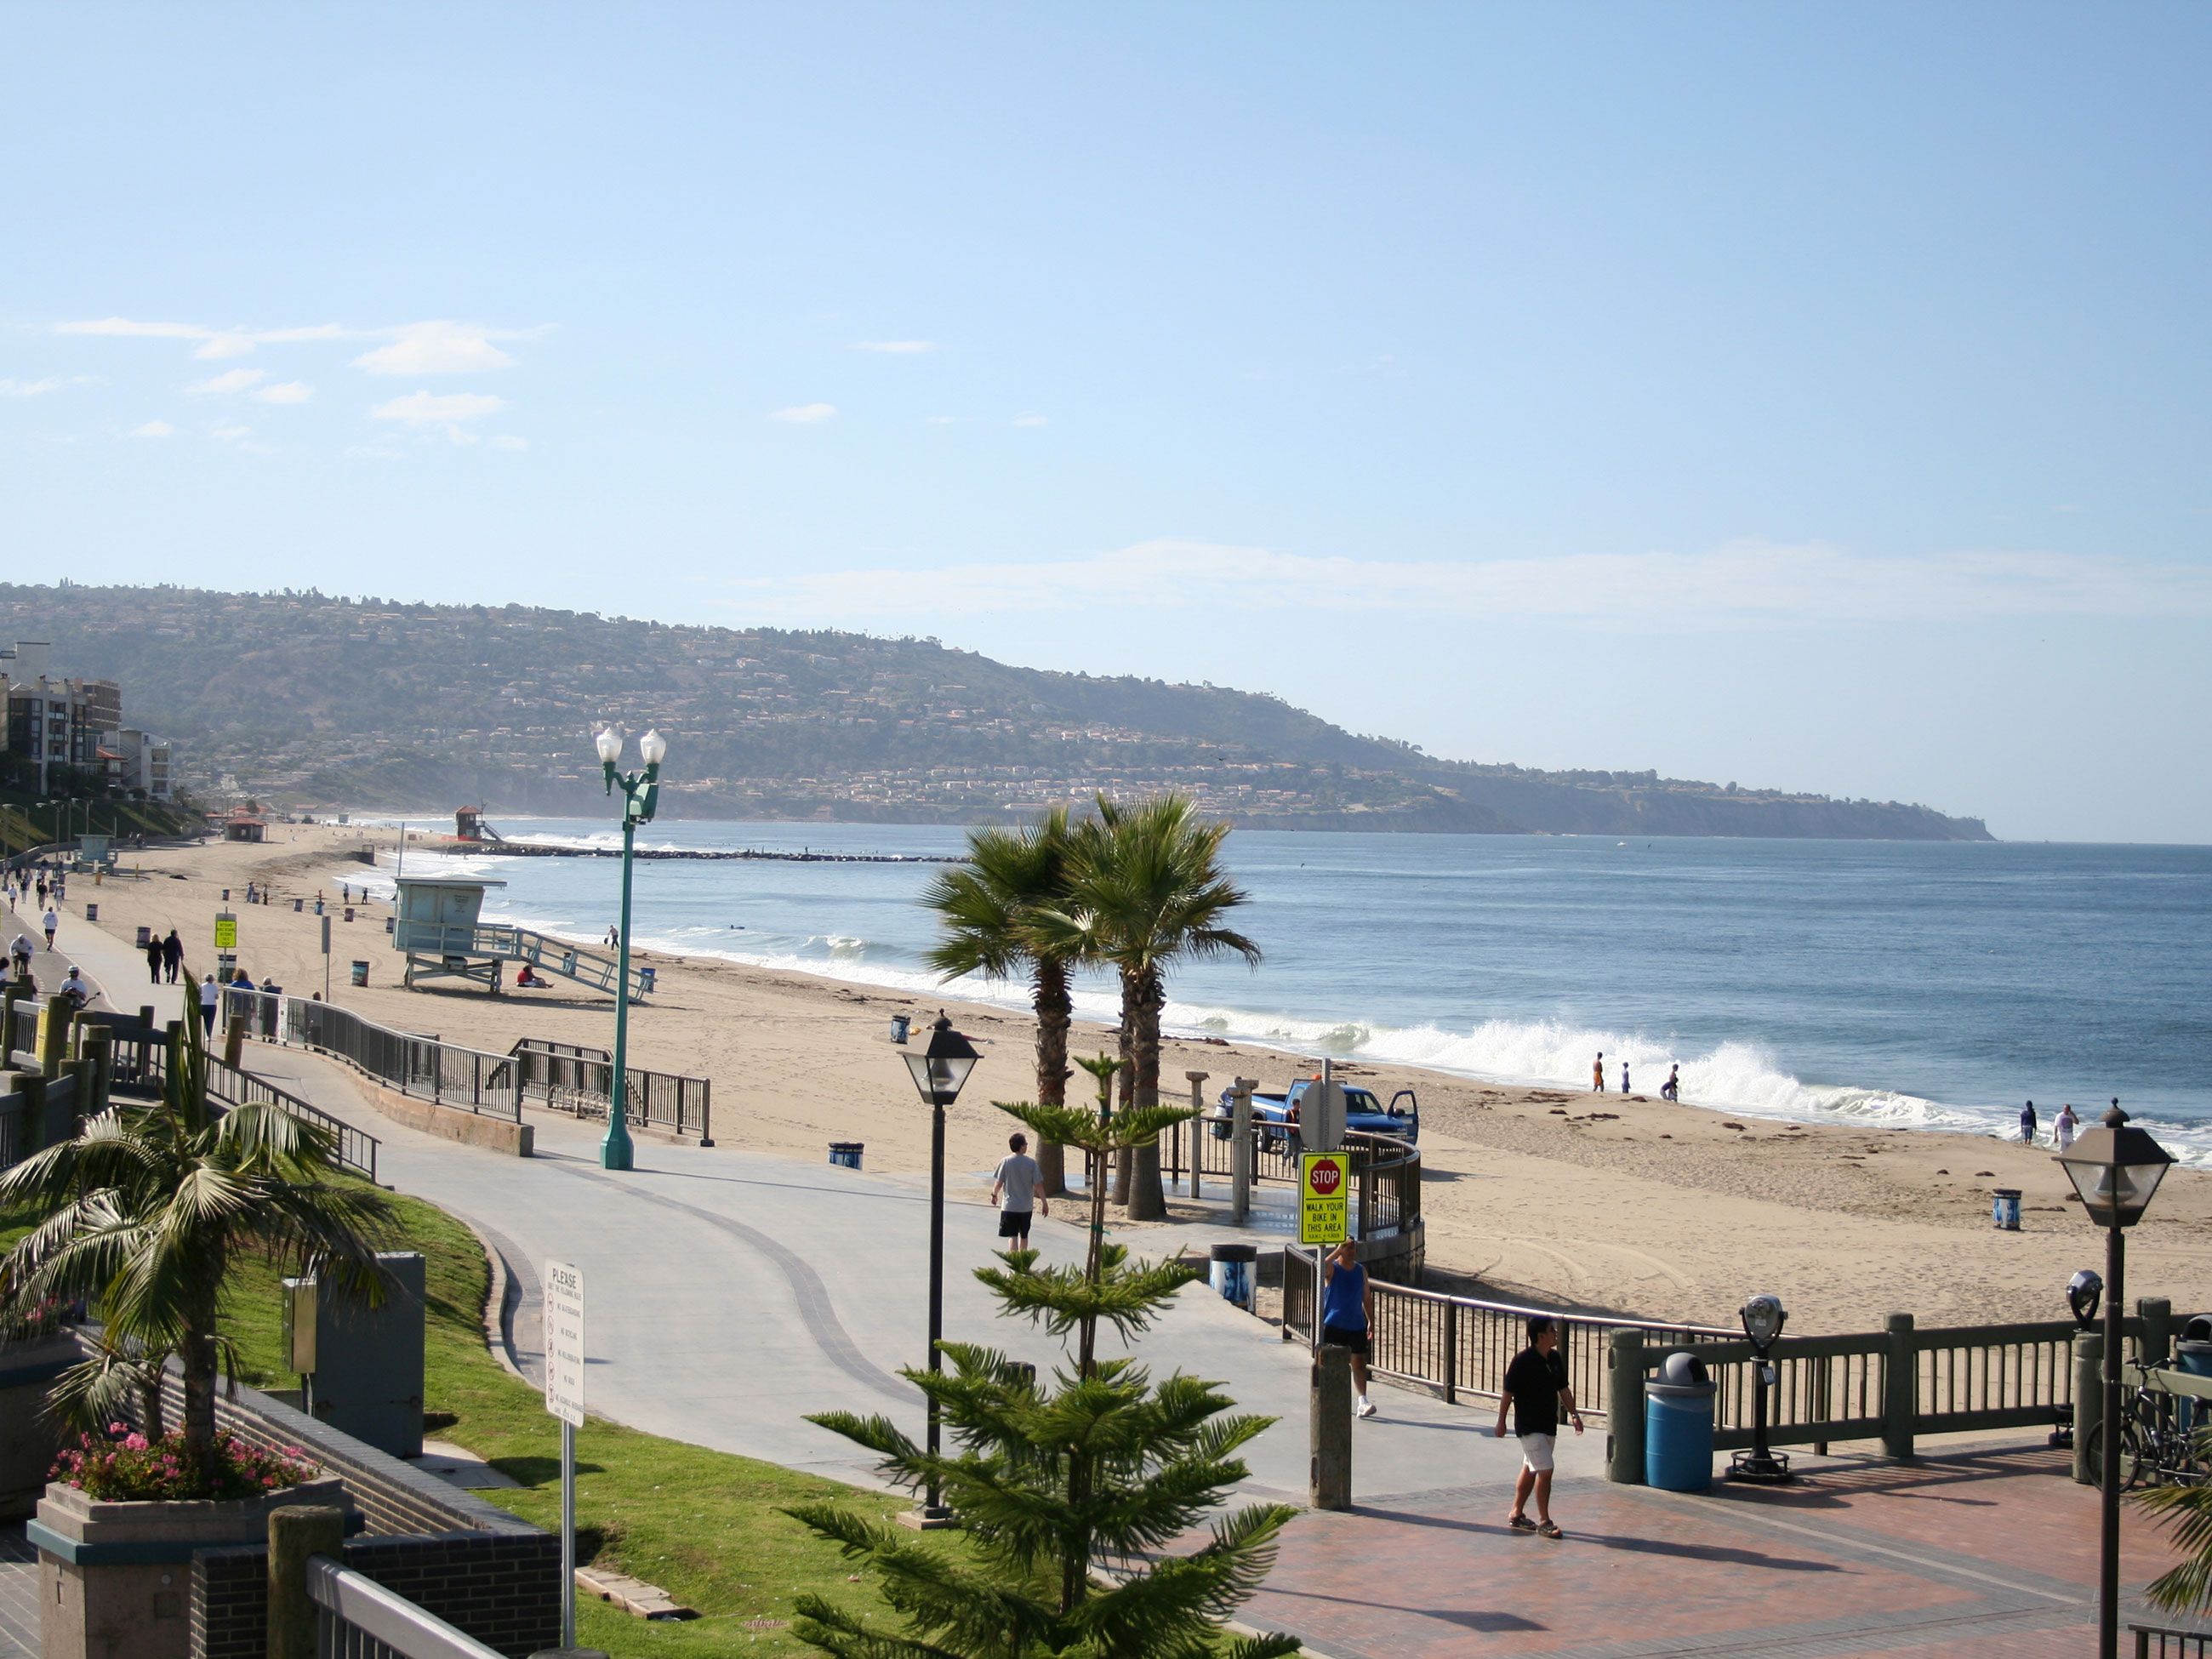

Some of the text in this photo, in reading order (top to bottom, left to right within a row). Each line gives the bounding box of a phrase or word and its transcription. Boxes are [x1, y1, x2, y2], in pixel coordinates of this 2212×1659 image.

[1312, 1170, 1338, 1184] STOP
[1326, 1202, 1343, 1211] YOUR
[1312, 1213, 1326, 1222] BIKE
[1307, 1223, 1321, 1232] THIS
[553, 1268, 576, 1289] PLEASE
